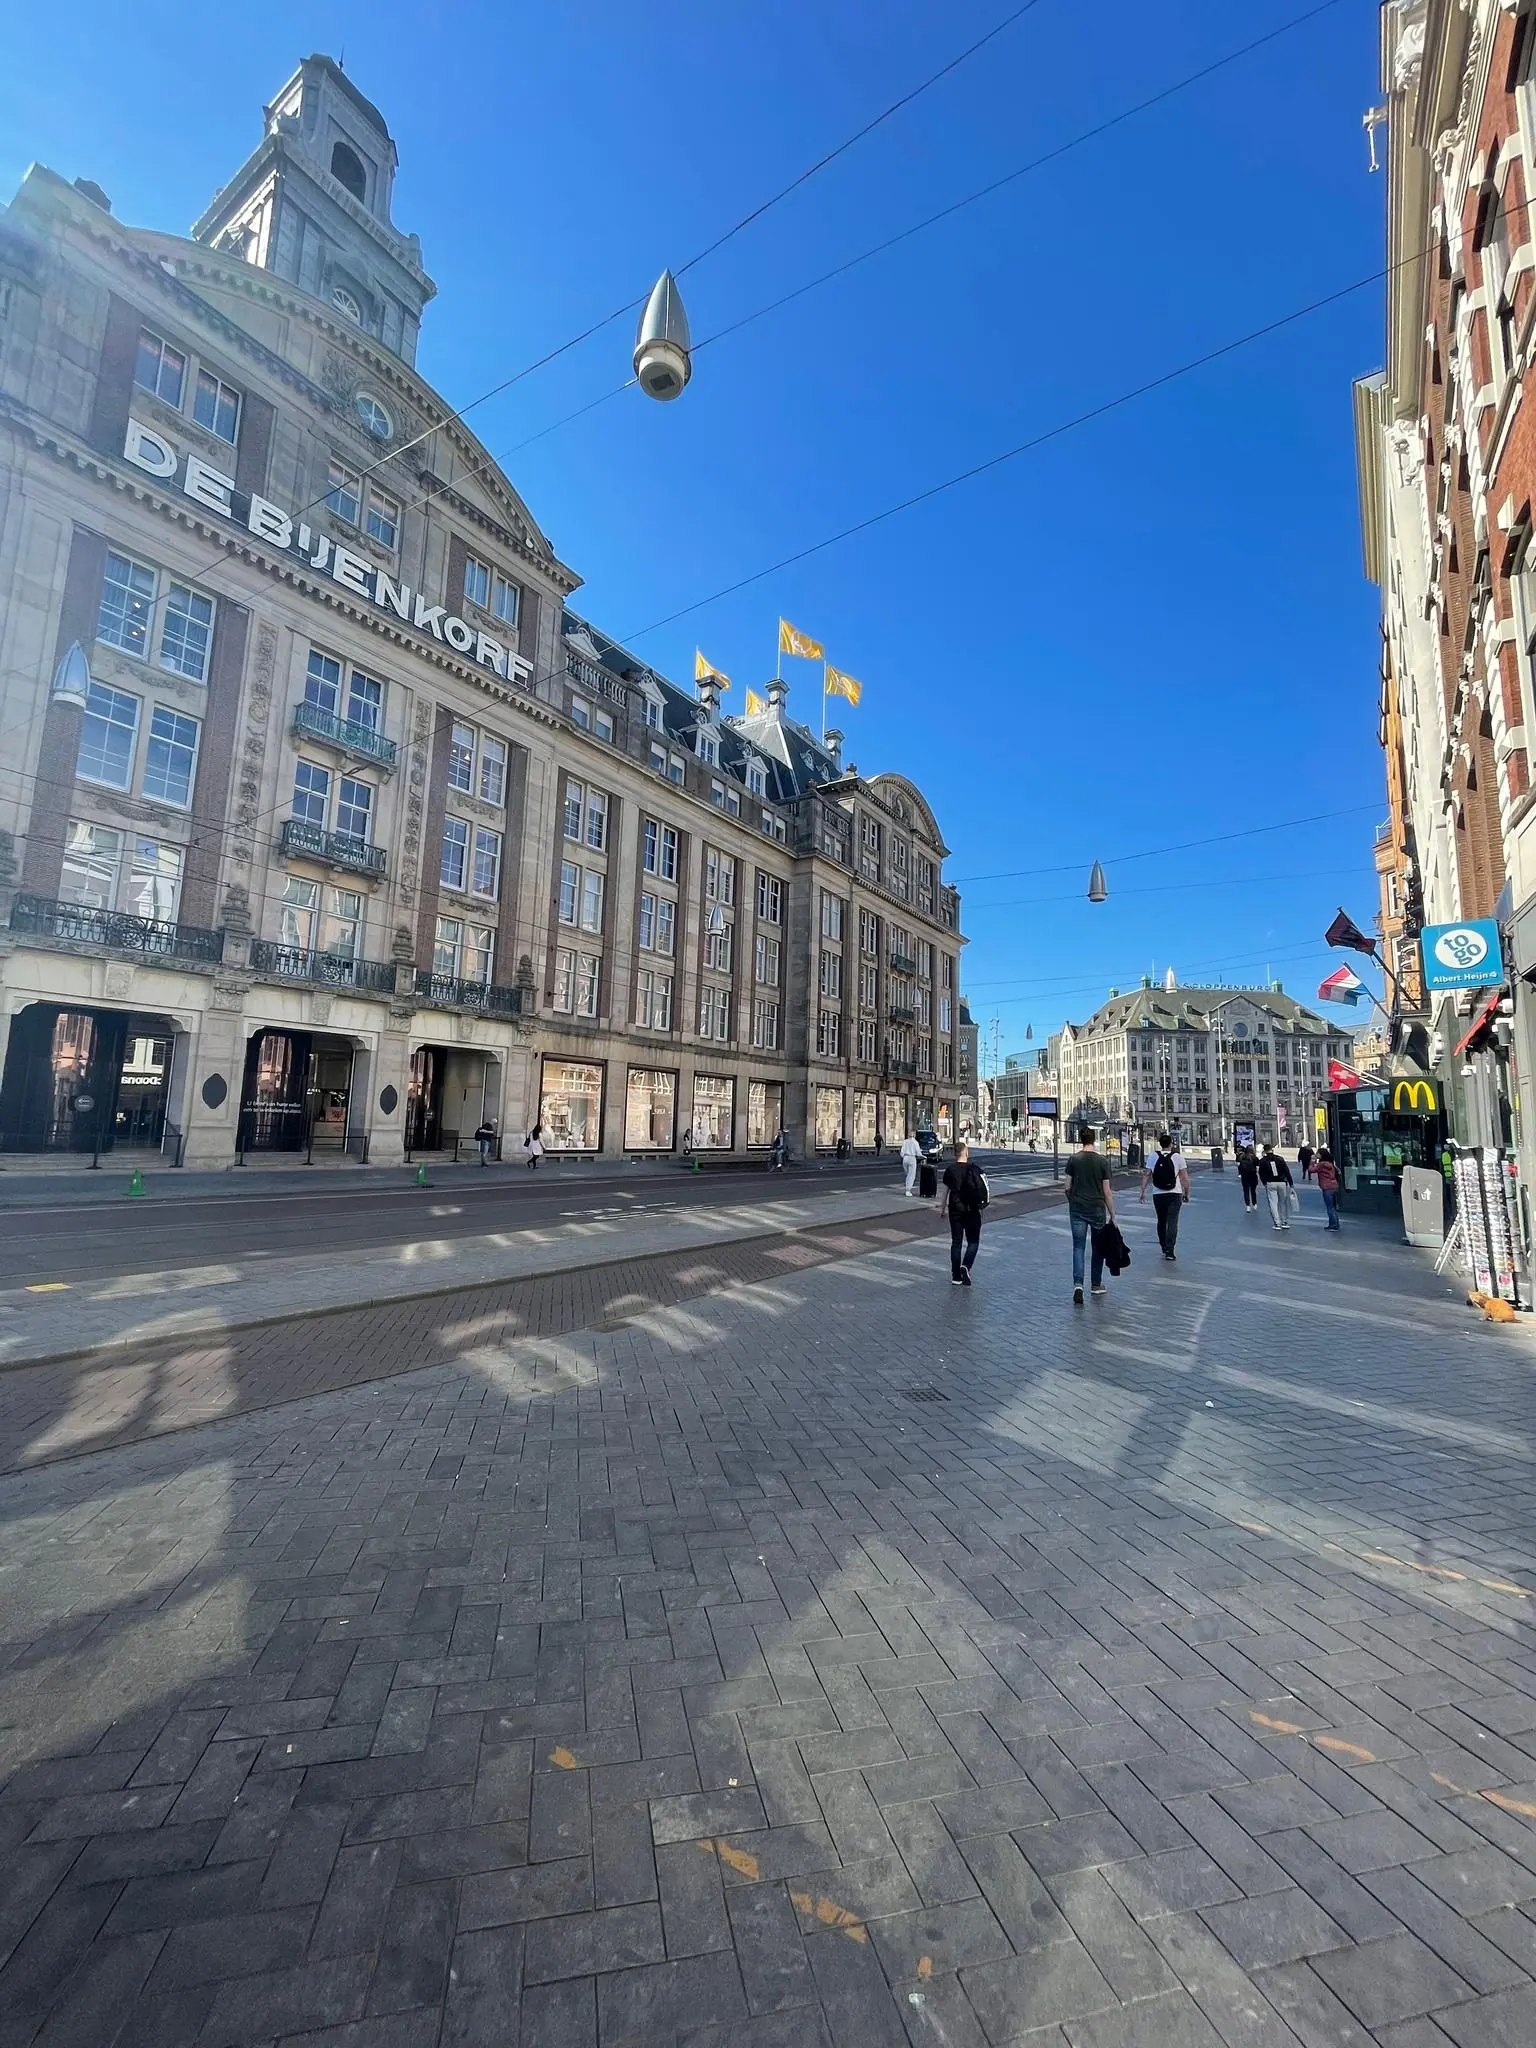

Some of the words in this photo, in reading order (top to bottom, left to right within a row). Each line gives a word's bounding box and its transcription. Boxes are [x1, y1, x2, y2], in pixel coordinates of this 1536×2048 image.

[124, 417, 235, 519] DE
[248, 493, 534, 684] BIJENKORF
[1444, 935, 1469, 951] to
[1454, 944, 1481, 965] go
[1433, 974, 1462, 983] Albert
[1463, 972, 1488, 981] Heijn
[1192, 983, 1271, 992] CLOPPENBURG
